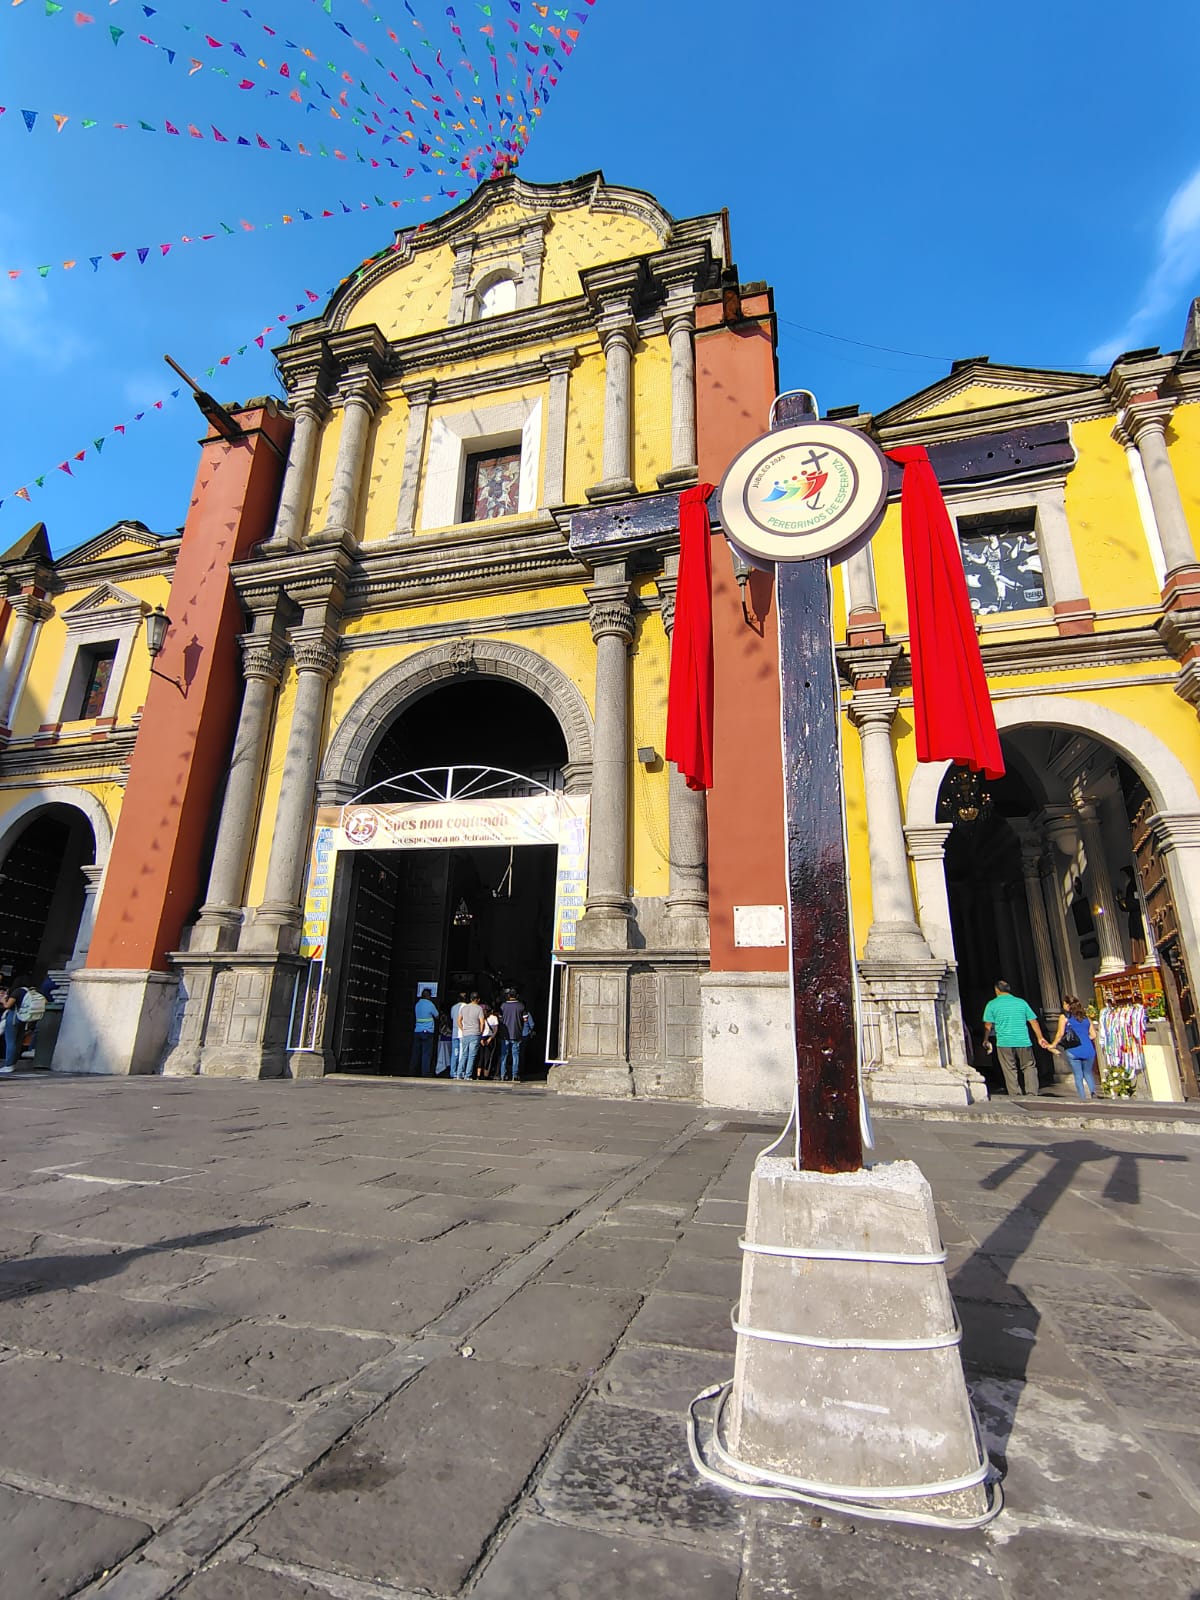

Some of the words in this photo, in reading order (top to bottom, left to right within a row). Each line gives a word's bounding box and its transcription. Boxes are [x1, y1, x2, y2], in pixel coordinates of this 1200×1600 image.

[752, 464, 771, 489] JUBILEO
[770, 454, 786, 467] 2025
[832, 458, 849, 504] ESPERANZA
[825, 503, 840, 516] DE
[767, 512, 827, 530] PEREGRINOS
[384, 818, 417, 832] Spes
[420, 818, 443, 830] non
[403, 835, 448, 845] espernza
